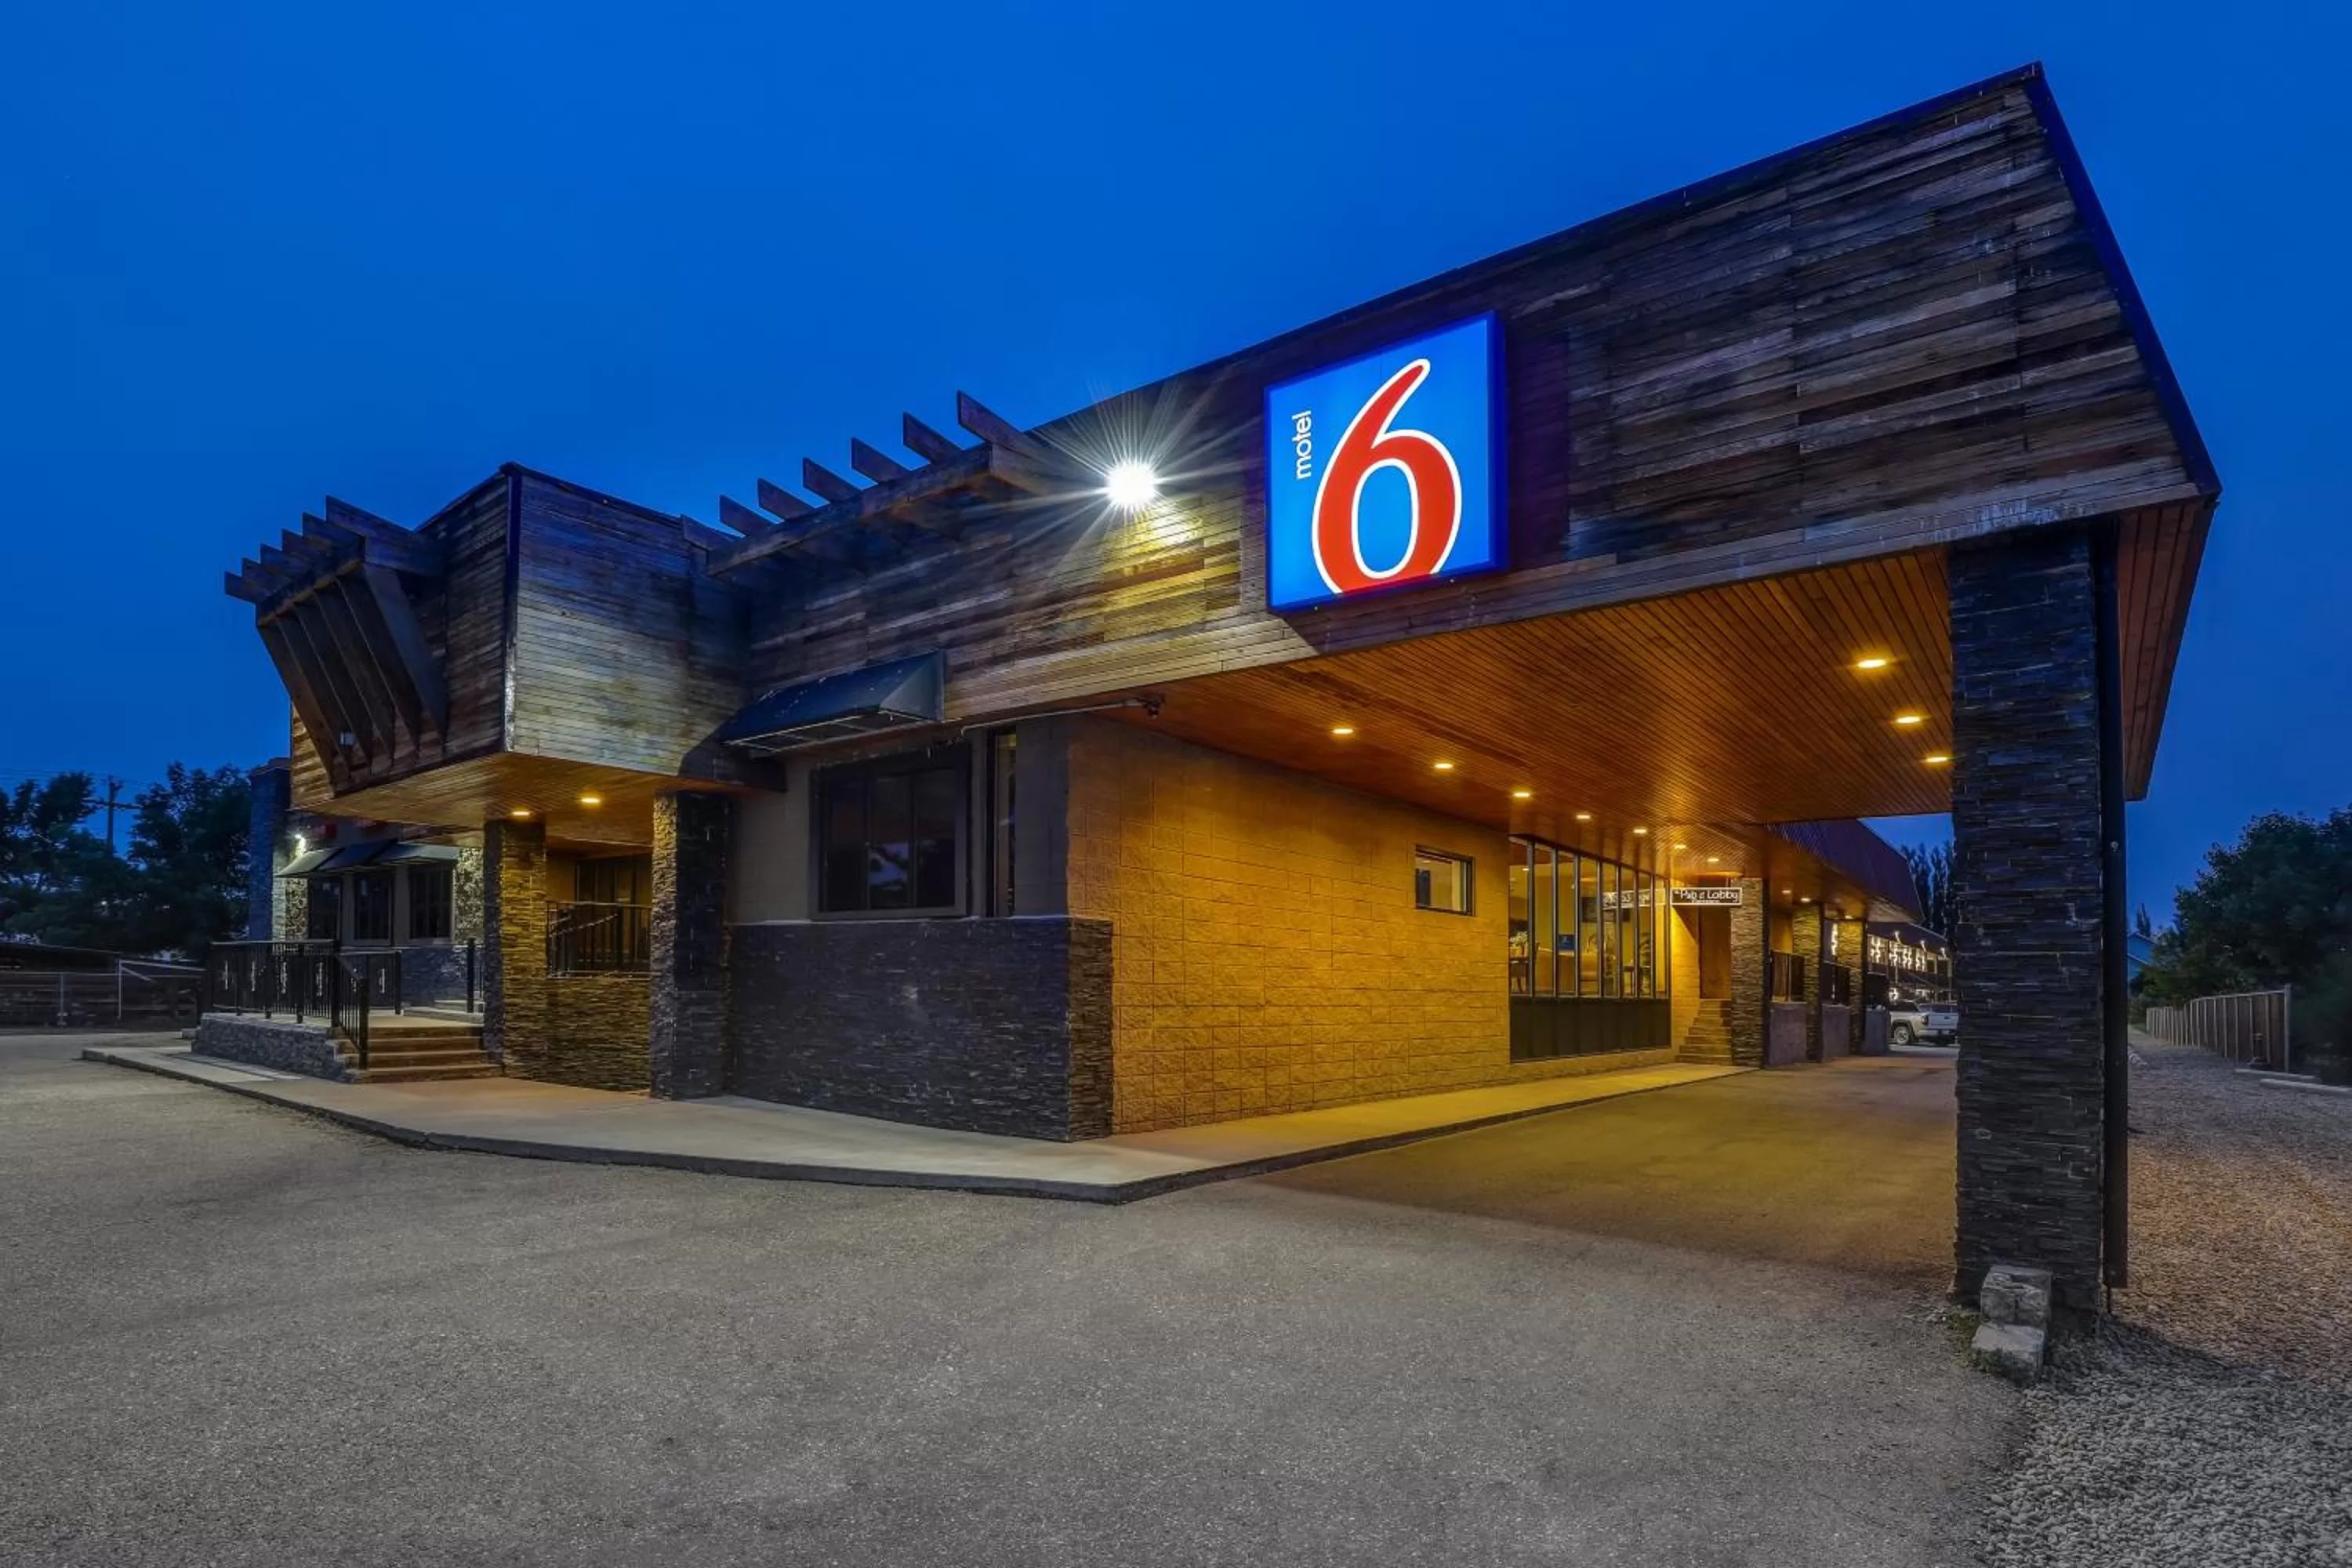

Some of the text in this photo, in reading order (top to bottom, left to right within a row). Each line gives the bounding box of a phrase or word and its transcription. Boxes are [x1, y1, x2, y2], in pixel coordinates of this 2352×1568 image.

[1291, 358, 1462, 593] motel 6
[1707, 890, 1738, 902] Lobby
